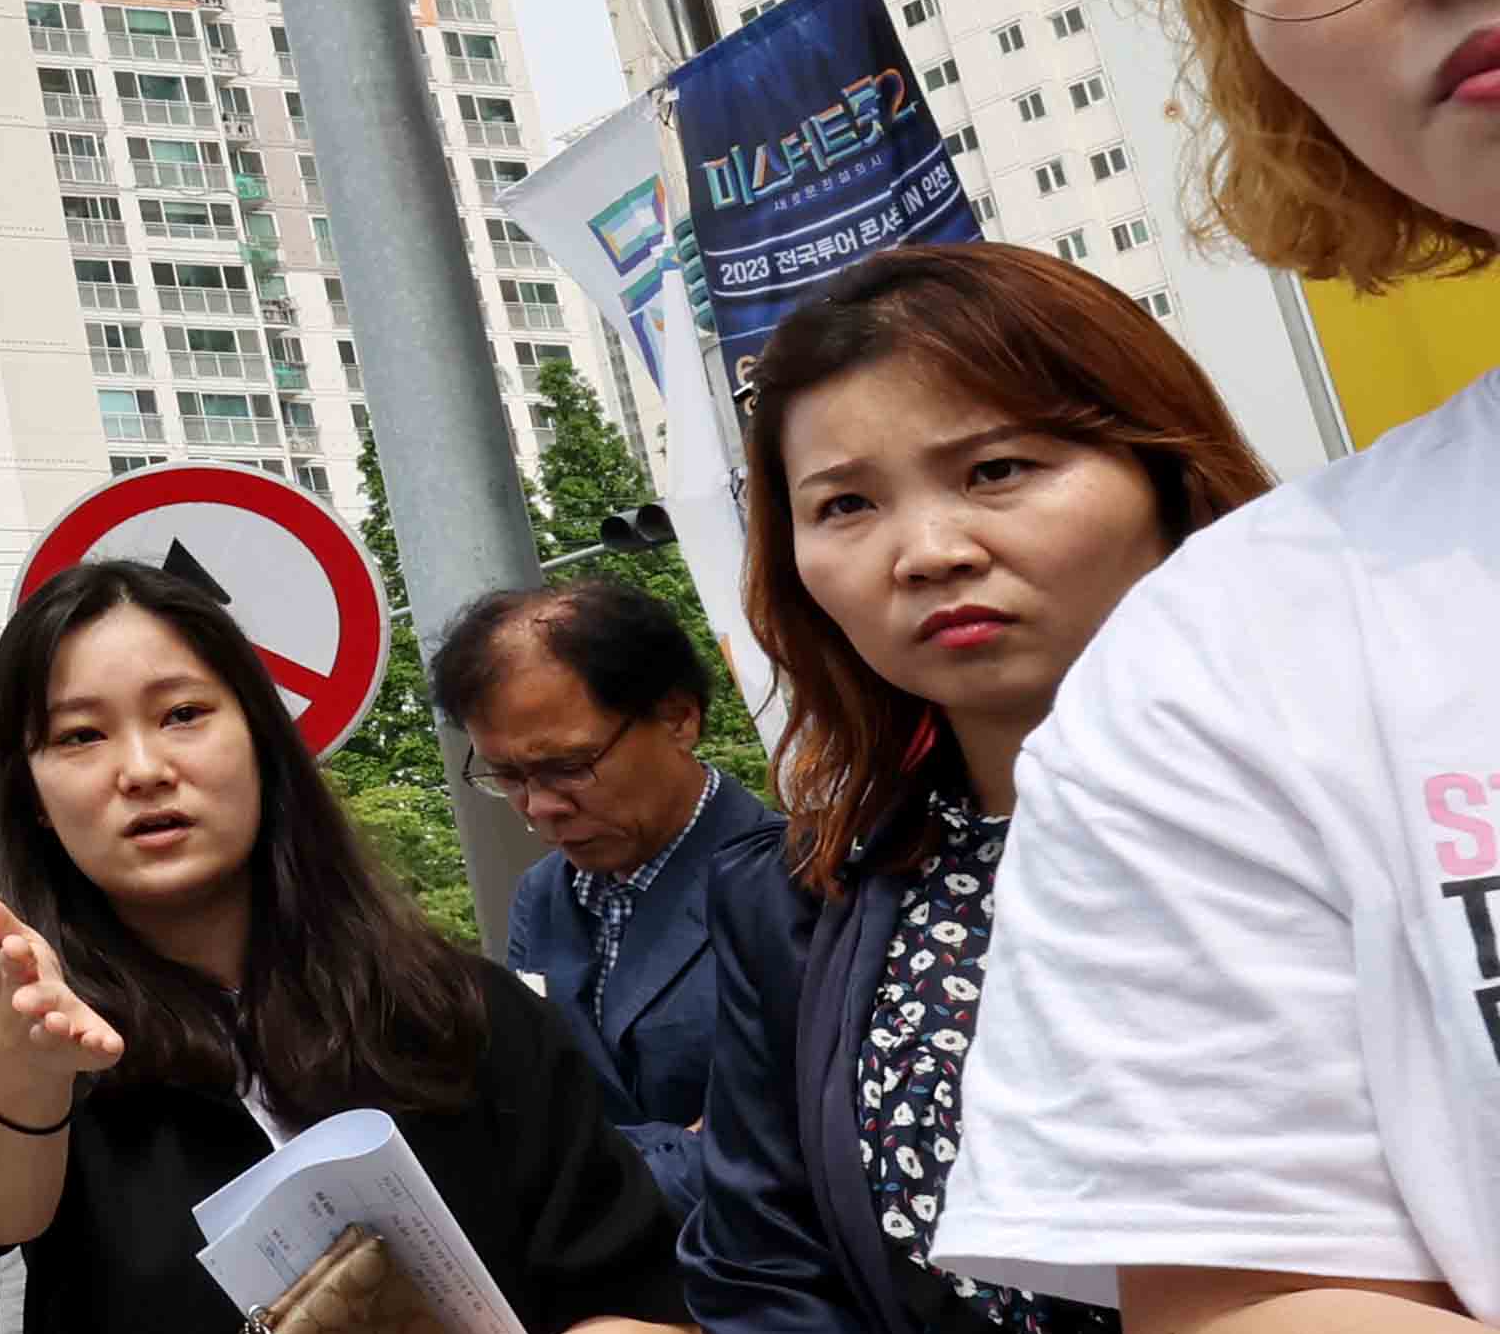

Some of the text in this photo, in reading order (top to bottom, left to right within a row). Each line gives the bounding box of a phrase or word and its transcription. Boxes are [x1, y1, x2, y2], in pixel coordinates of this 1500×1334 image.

[719, 256, 771, 286] 2023
[774, 230, 859, 276] 전국투어
[1424, 772, 1500, 876] S
